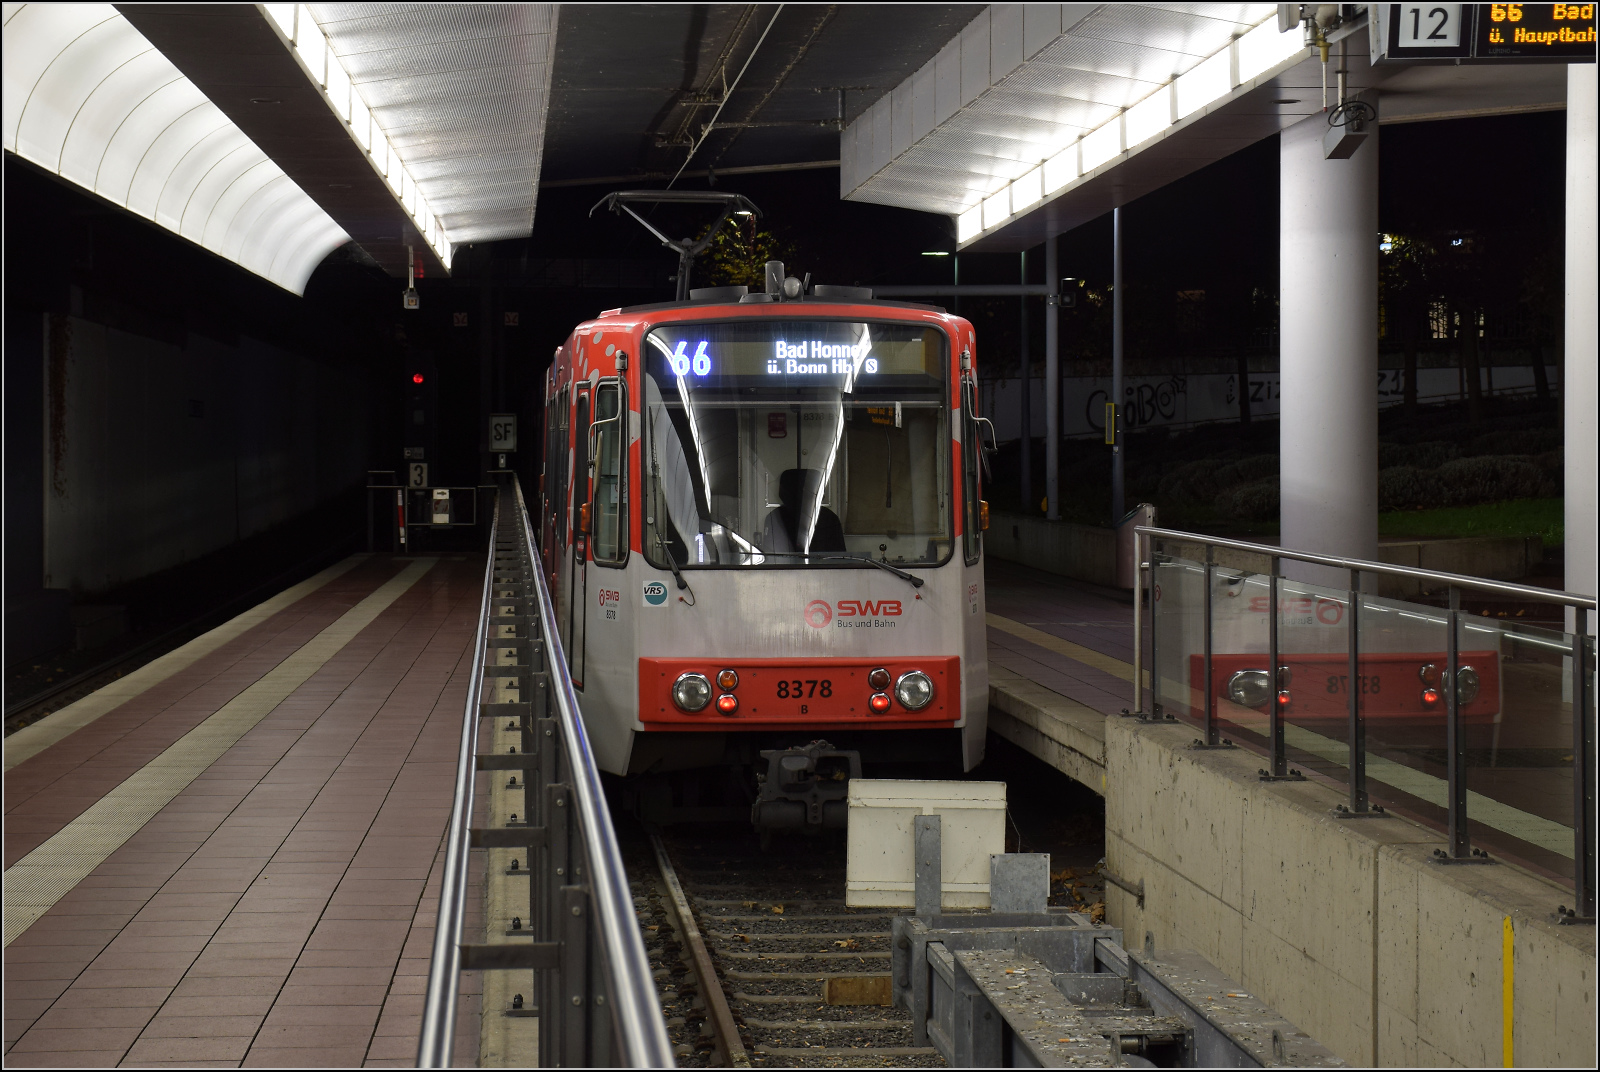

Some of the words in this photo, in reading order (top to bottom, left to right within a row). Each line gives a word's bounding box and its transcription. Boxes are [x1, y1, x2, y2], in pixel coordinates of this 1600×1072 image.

[1491, 4, 1523, 21] 66
[1553, 4, 1593, 19] Bad
[1409, 8, 1448, 40] 12
[1489, 28, 1504, 42] ü.
[1514, 27, 1596, 45] Hauptbah
[672, 341, 711, 376] 66
[776, 341, 806, 358] Bad
[767, 360, 782, 374] ü.
[786, 360, 827, 374] Bonn
[494, 423, 512, 441] SF
[413, 465, 424, 486] 3
[605, 590, 620, 602] SWB
[643, 587, 662, 595] VRS
[837, 600, 902, 616] SWB
[838, 620, 853, 628] Bus
[855, 620, 872, 628] und
[874, 620, 896, 628] Bahn
[777, 680, 832, 699] 8378
[800, 705, 809, 714] B
